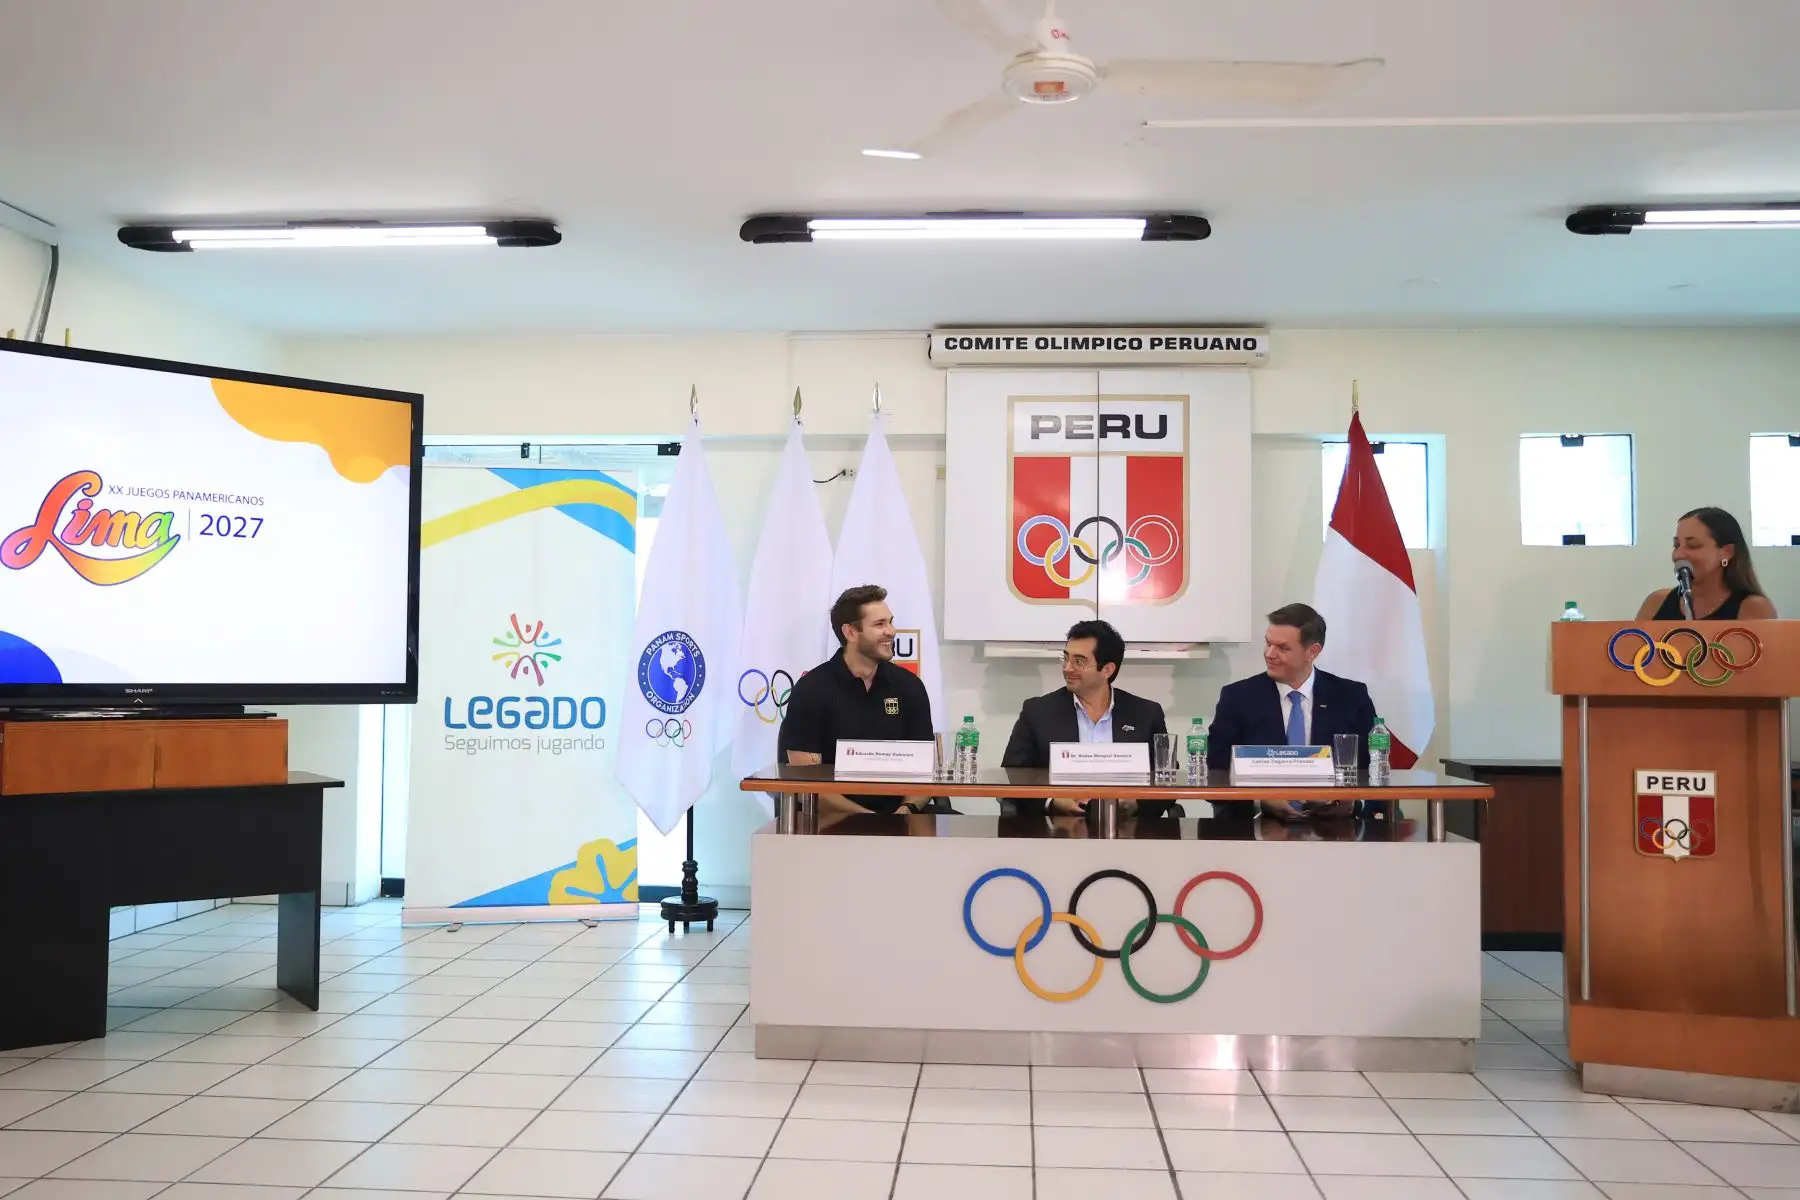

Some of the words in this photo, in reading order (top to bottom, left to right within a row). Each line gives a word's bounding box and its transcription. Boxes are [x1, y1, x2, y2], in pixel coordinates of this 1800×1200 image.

[944, 336, 1028, 351] COMITE
[1035, 336, 1143, 351] OLIMPICO
[1150, 336, 1258, 351] PERUANO
[1030, 413, 1168, 439] PERU
[108, 484, 124, 495] XX
[126, 487, 170, 499] JUEGOS
[172, 490, 265, 506] PANAMERICANOS
[0, 470, 181, 586] Lima
[199, 513, 264, 538] 2027
[646, 632, 674, 656] PANAM
[675, 632, 701, 658] SPORTS
[444, 734, 531, 755] Seguimos
[536, 734, 605, 755] jugando
[1646, 775, 1707, 791] PERU
